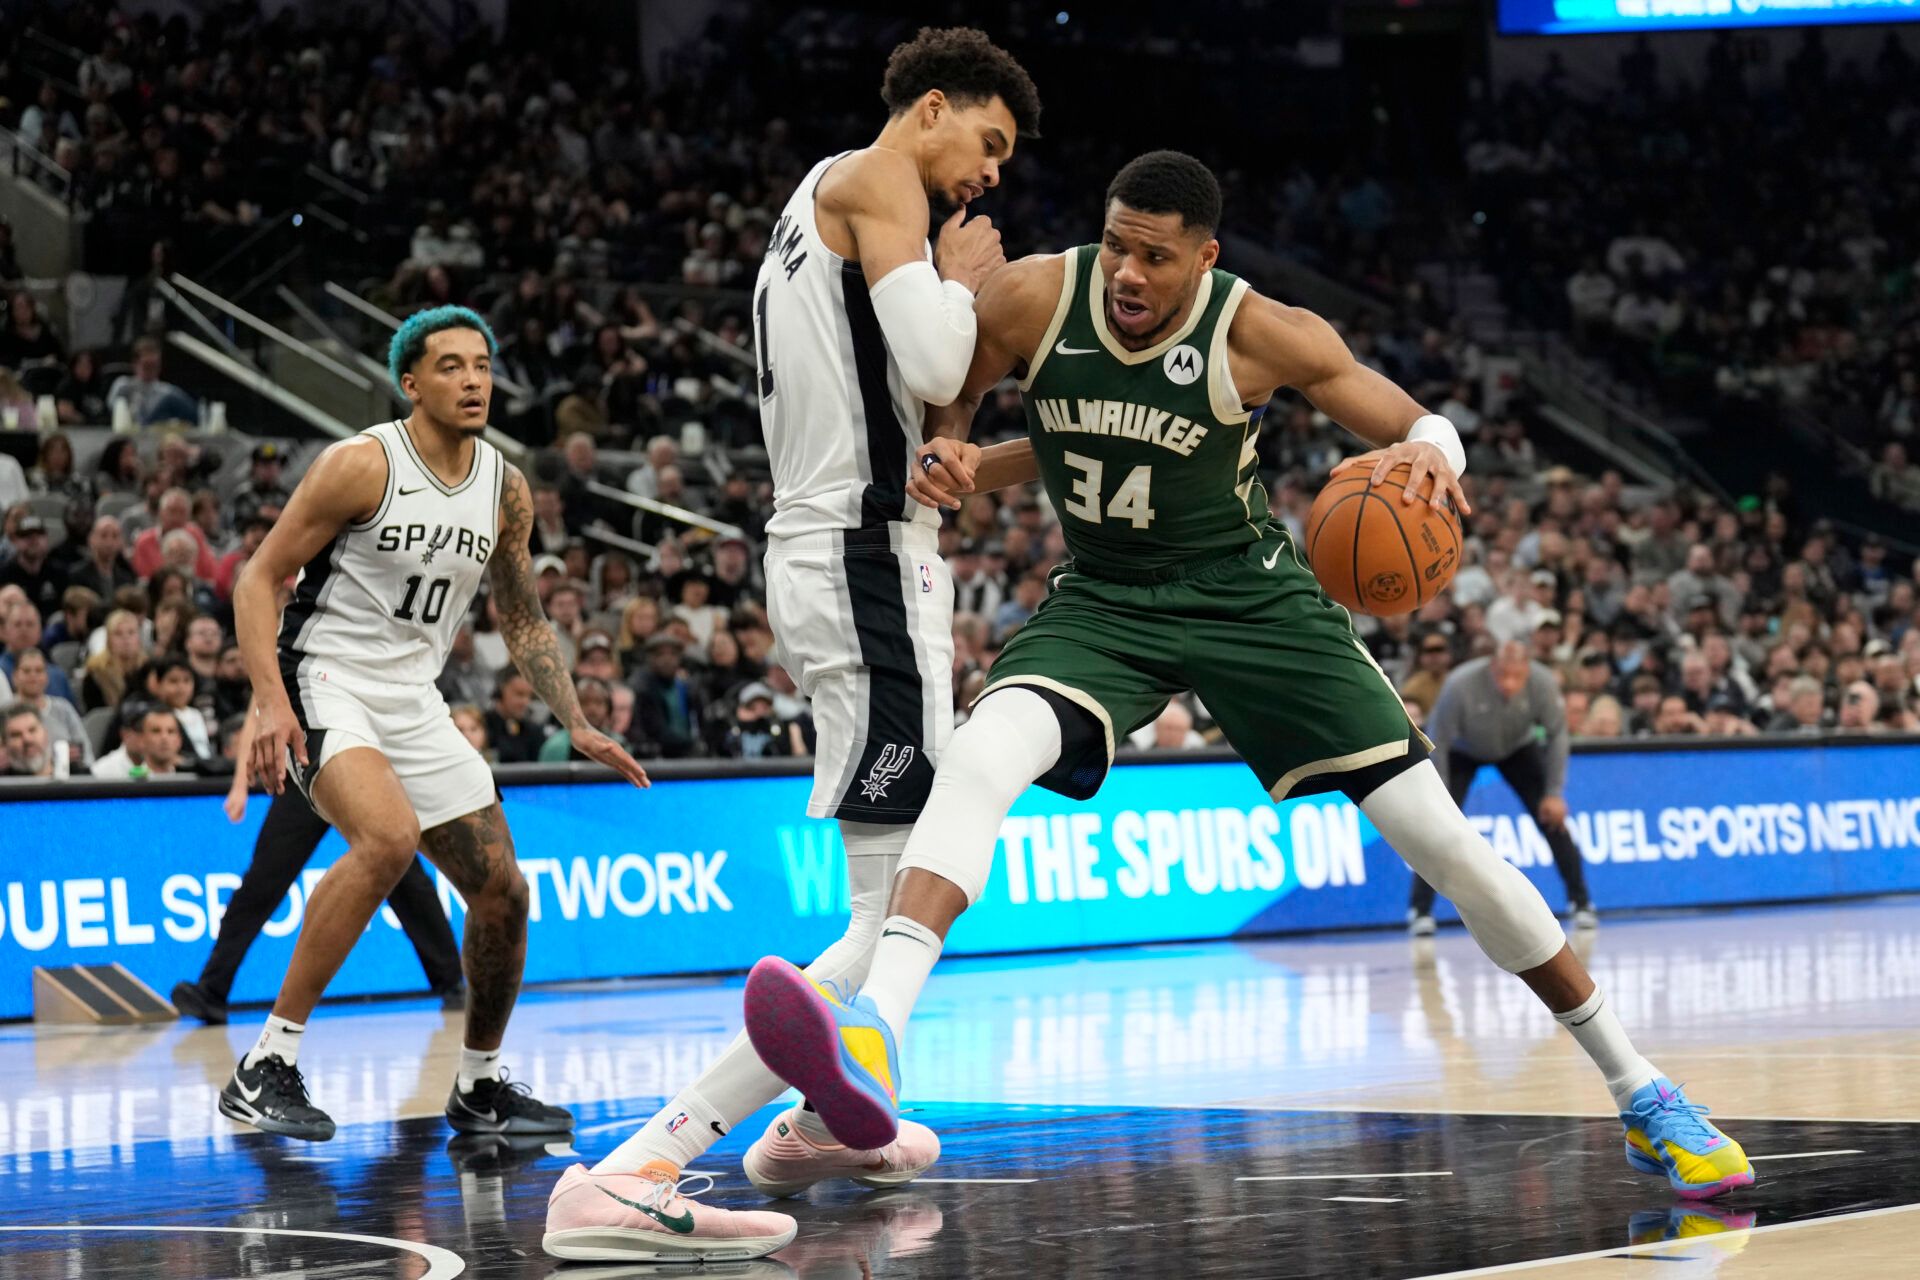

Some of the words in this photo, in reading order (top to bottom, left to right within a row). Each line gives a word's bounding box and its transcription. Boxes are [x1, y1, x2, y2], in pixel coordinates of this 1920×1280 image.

[757, 285, 775, 401] 1
[1034, 398, 1209, 457] MILWAUKEE
[1064, 450, 1155, 530] 34
[377, 524, 490, 565] SPURS
[394, 575, 451, 624] 10
[998, 813, 1109, 905] THE
[1112, 805, 1286, 899] SPURS
[1289, 802, 1367, 890] ON
[1467, 808, 1661, 868] FANUEL
[1658, 802, 1806, 861] SPORTS
[0, 877, 156, 951] UEL
